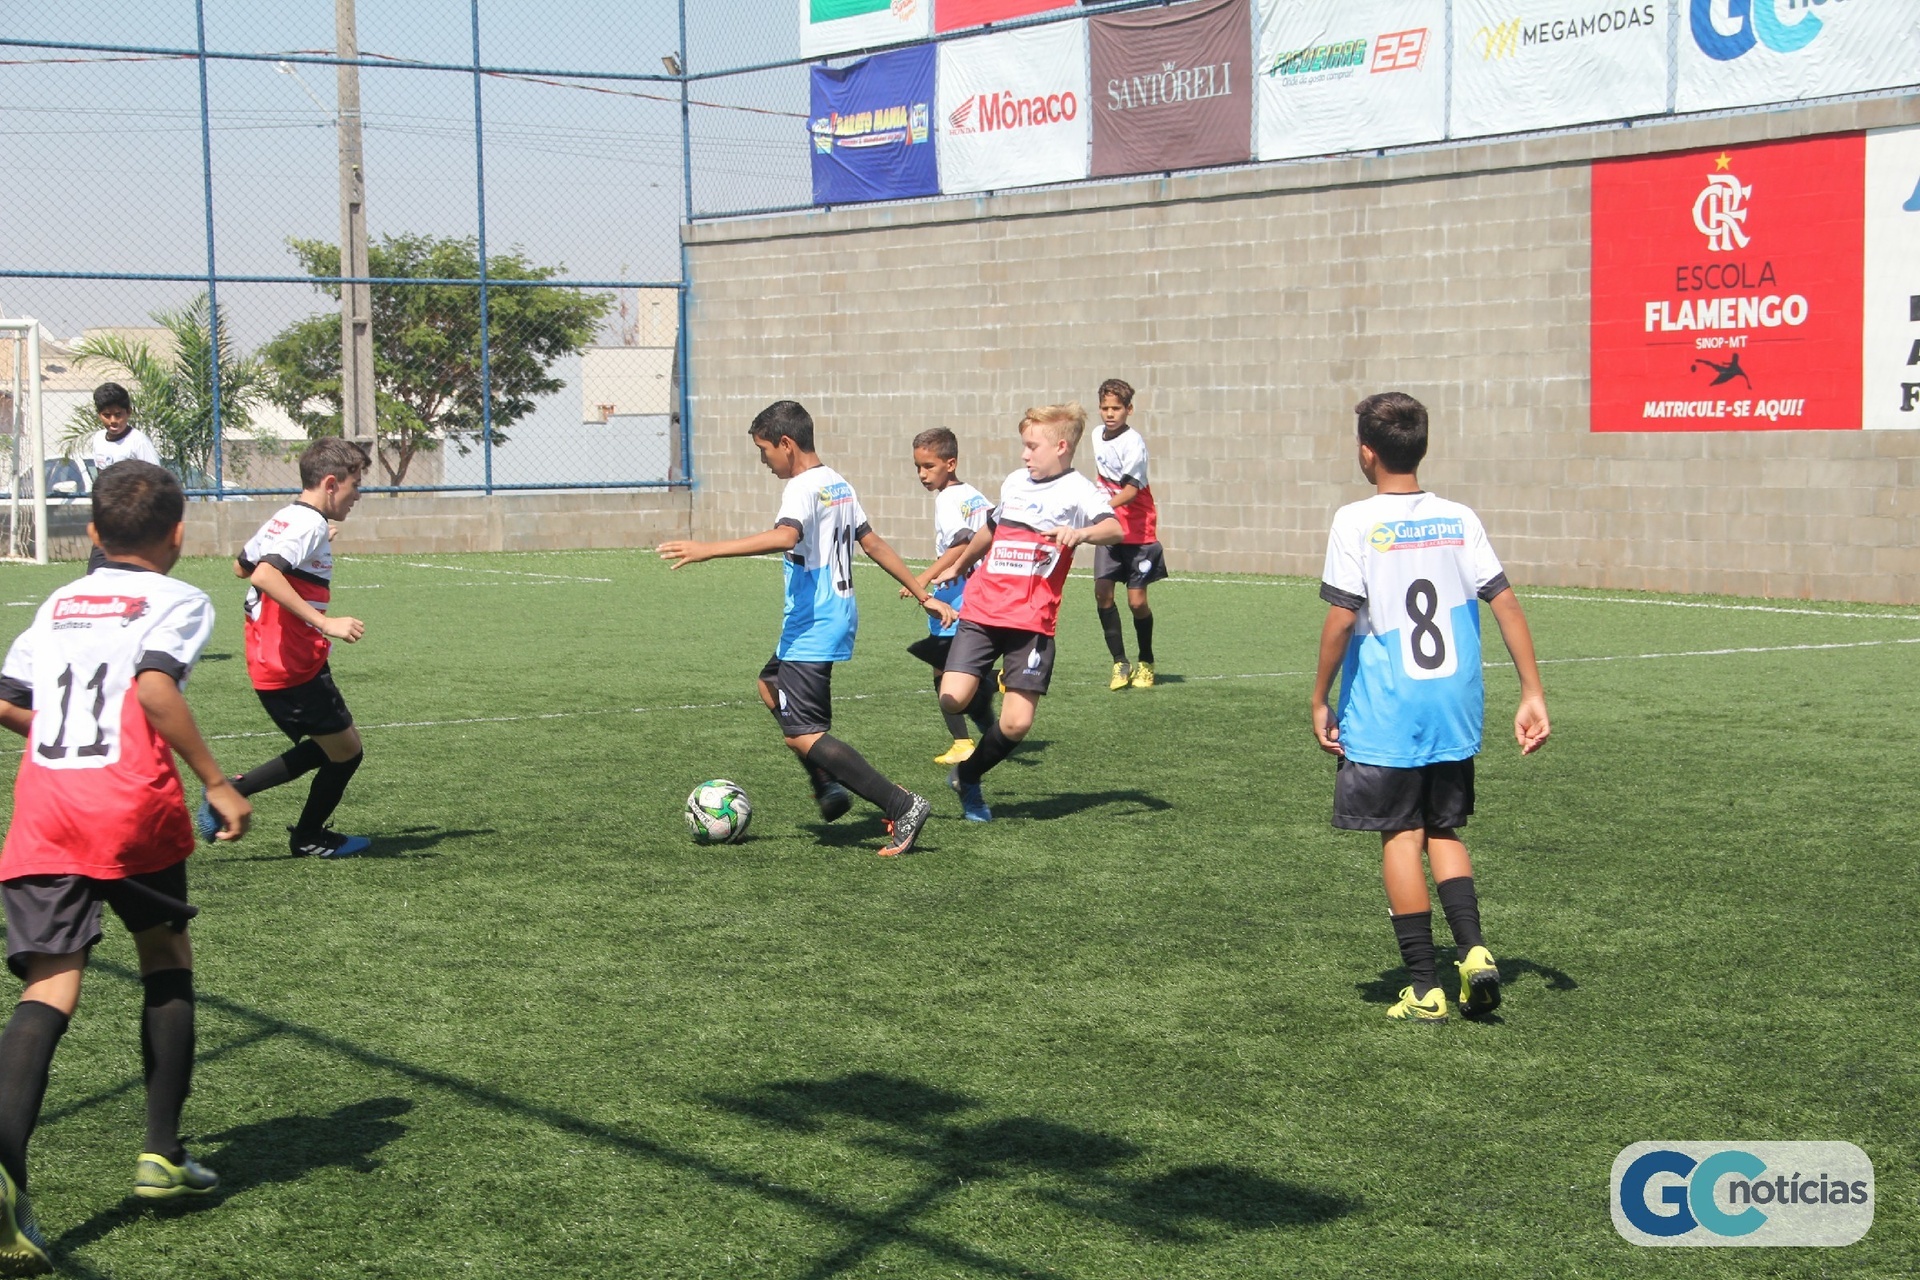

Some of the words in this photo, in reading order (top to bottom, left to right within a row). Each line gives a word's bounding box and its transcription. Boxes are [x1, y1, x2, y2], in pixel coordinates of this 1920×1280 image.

[1523, 4, 1655, 46] MEGAMODAS
[978, 90, 1077, 133] Mônaco
[949, 127, 976, 136] HONDA
[1676, 261, 1776, 292] ESCOLA
[1645, 294, 1808, 332] FLAMENGO
[1695, 335, 1748, 350] SINOP-MT
[1643, 400, 1751, 418] MATRICULE-SE
[1754, 399, 1805, 421] AQUI!
[1394, 520, 1463, 539] Guarapiri
[1406, 578, 1446, 670] 8
[37, 662, 110, 760] 11
